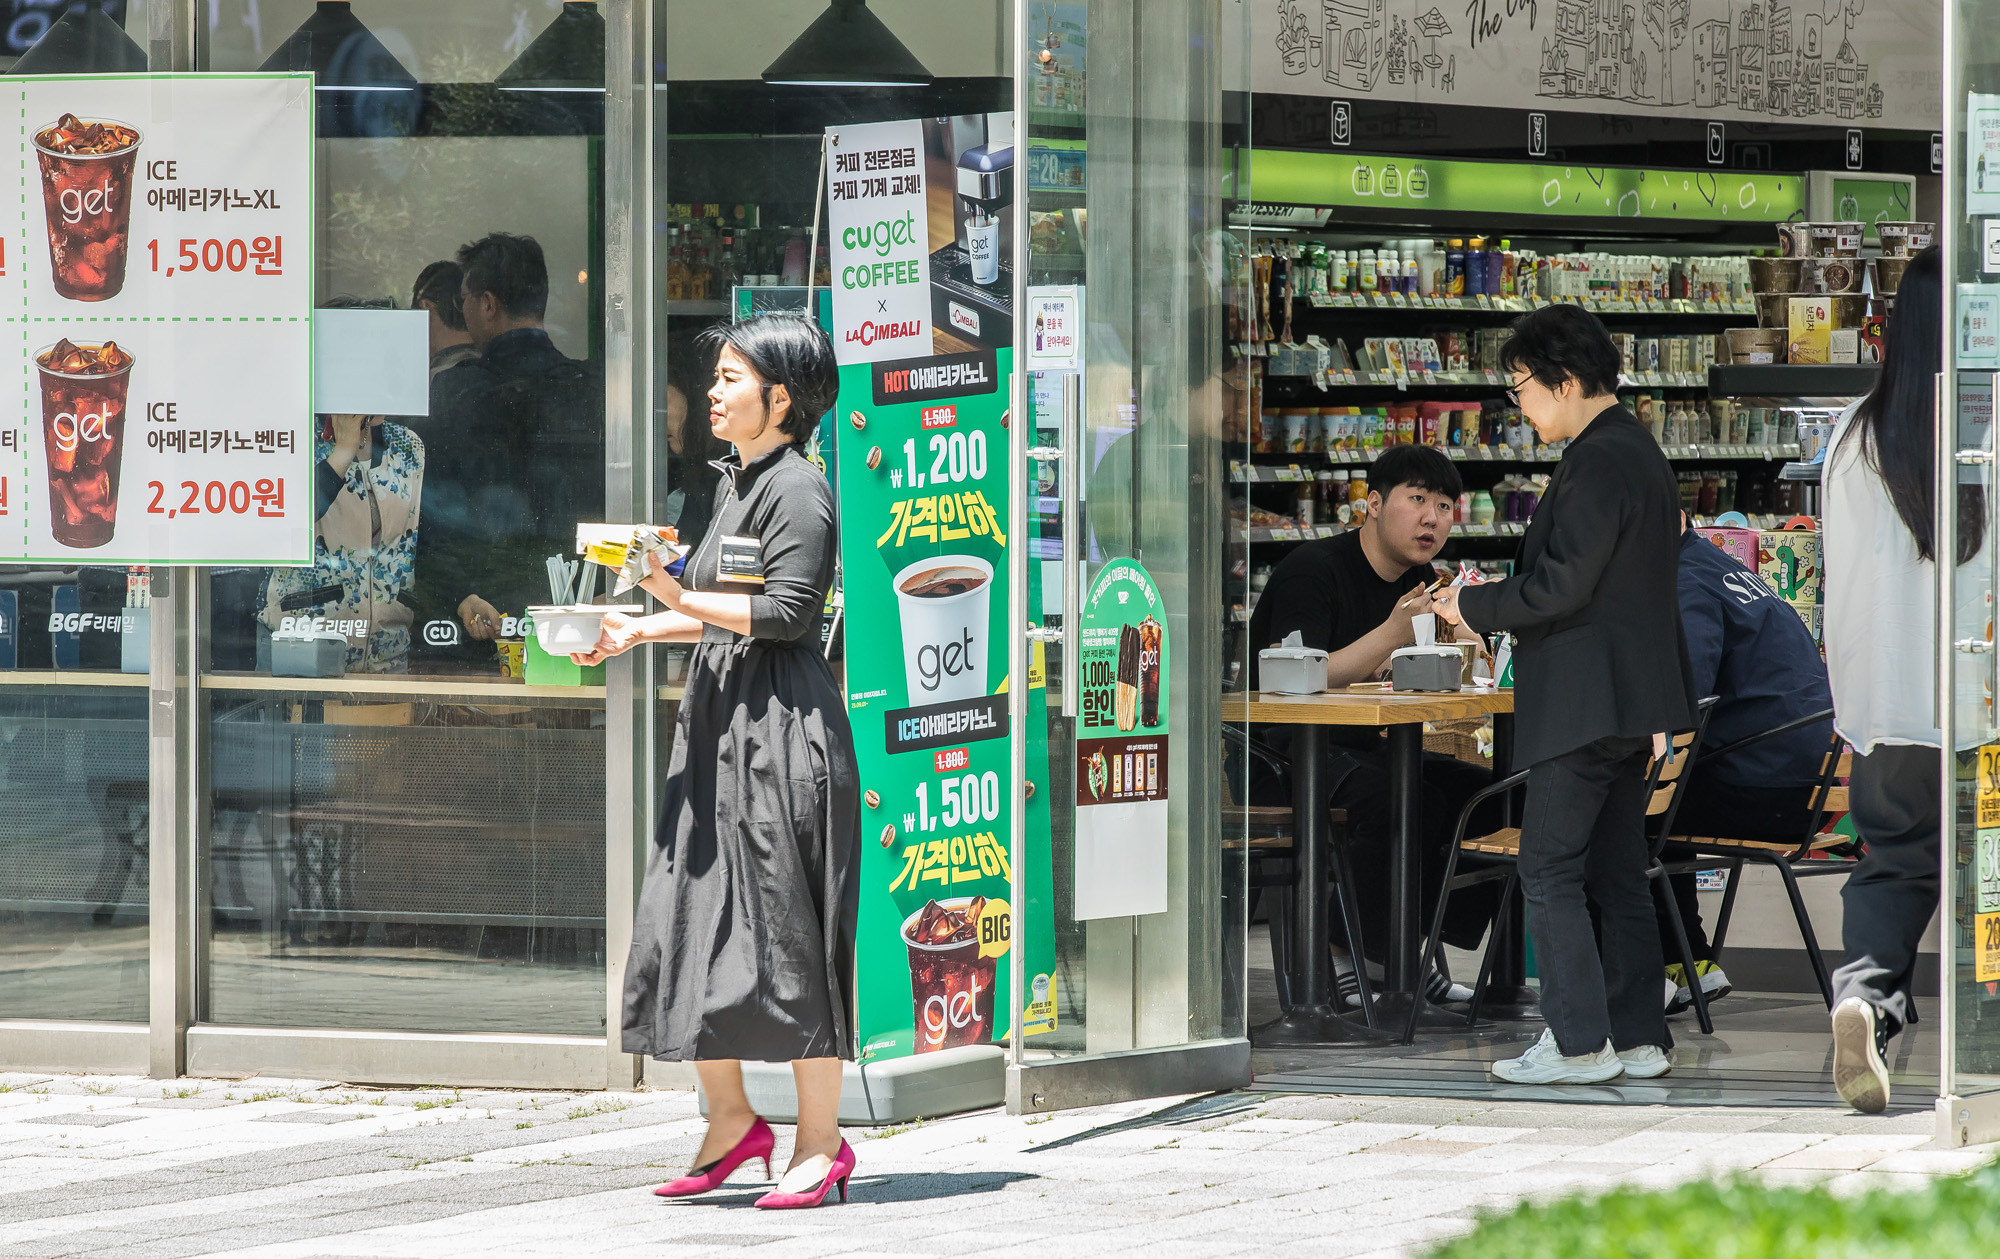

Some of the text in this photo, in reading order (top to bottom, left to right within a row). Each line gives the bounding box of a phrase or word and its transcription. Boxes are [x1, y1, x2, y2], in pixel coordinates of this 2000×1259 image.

[147, 160, 178, 181] ICE
[836, 147, 916, 173] 커피 전문점급
[59, 179, 114, 224] get
[147, 187, 281, 212] 아메리카노XL
[833, 174, 921, 201] 커피 기계 교체!
[147, 235, 283, 278] 1,500원
[971, 235, 989, 253] get
[842, 260, 920, 290] COFFEE
[1047, 318, 1057, 330] 문을
[1805, 306, 1816, 332] 보리차
[884, 362, 989, 394] HOT아메리카노L
[147, 402, 177, 422] ICE
[53, 402, 113, 452] get
[147, 429, 296, 454] 아메리카노벤티
[147, 477, 286, 519] 2,200원
[876, 490, 1007, 549] 가격인하
[48, 612, 135, 634] BGF리테일
[279, 616, 368, 638] BGF리테일
[429, 625, 450, 639] CU
[918, 626, 975, 692] get
[1141, 645, 1158, 672] get
[1082, 660, 1116, 688] 1,000원
[1083, 689, 1115, 728] 할인
[898, 706, 997, 742] ICE아메리카노L
[889, 831, 1011, 894] 가격인하
[982, 913, 1011, 944] BIG
[924, 974, 982, 1045] get
